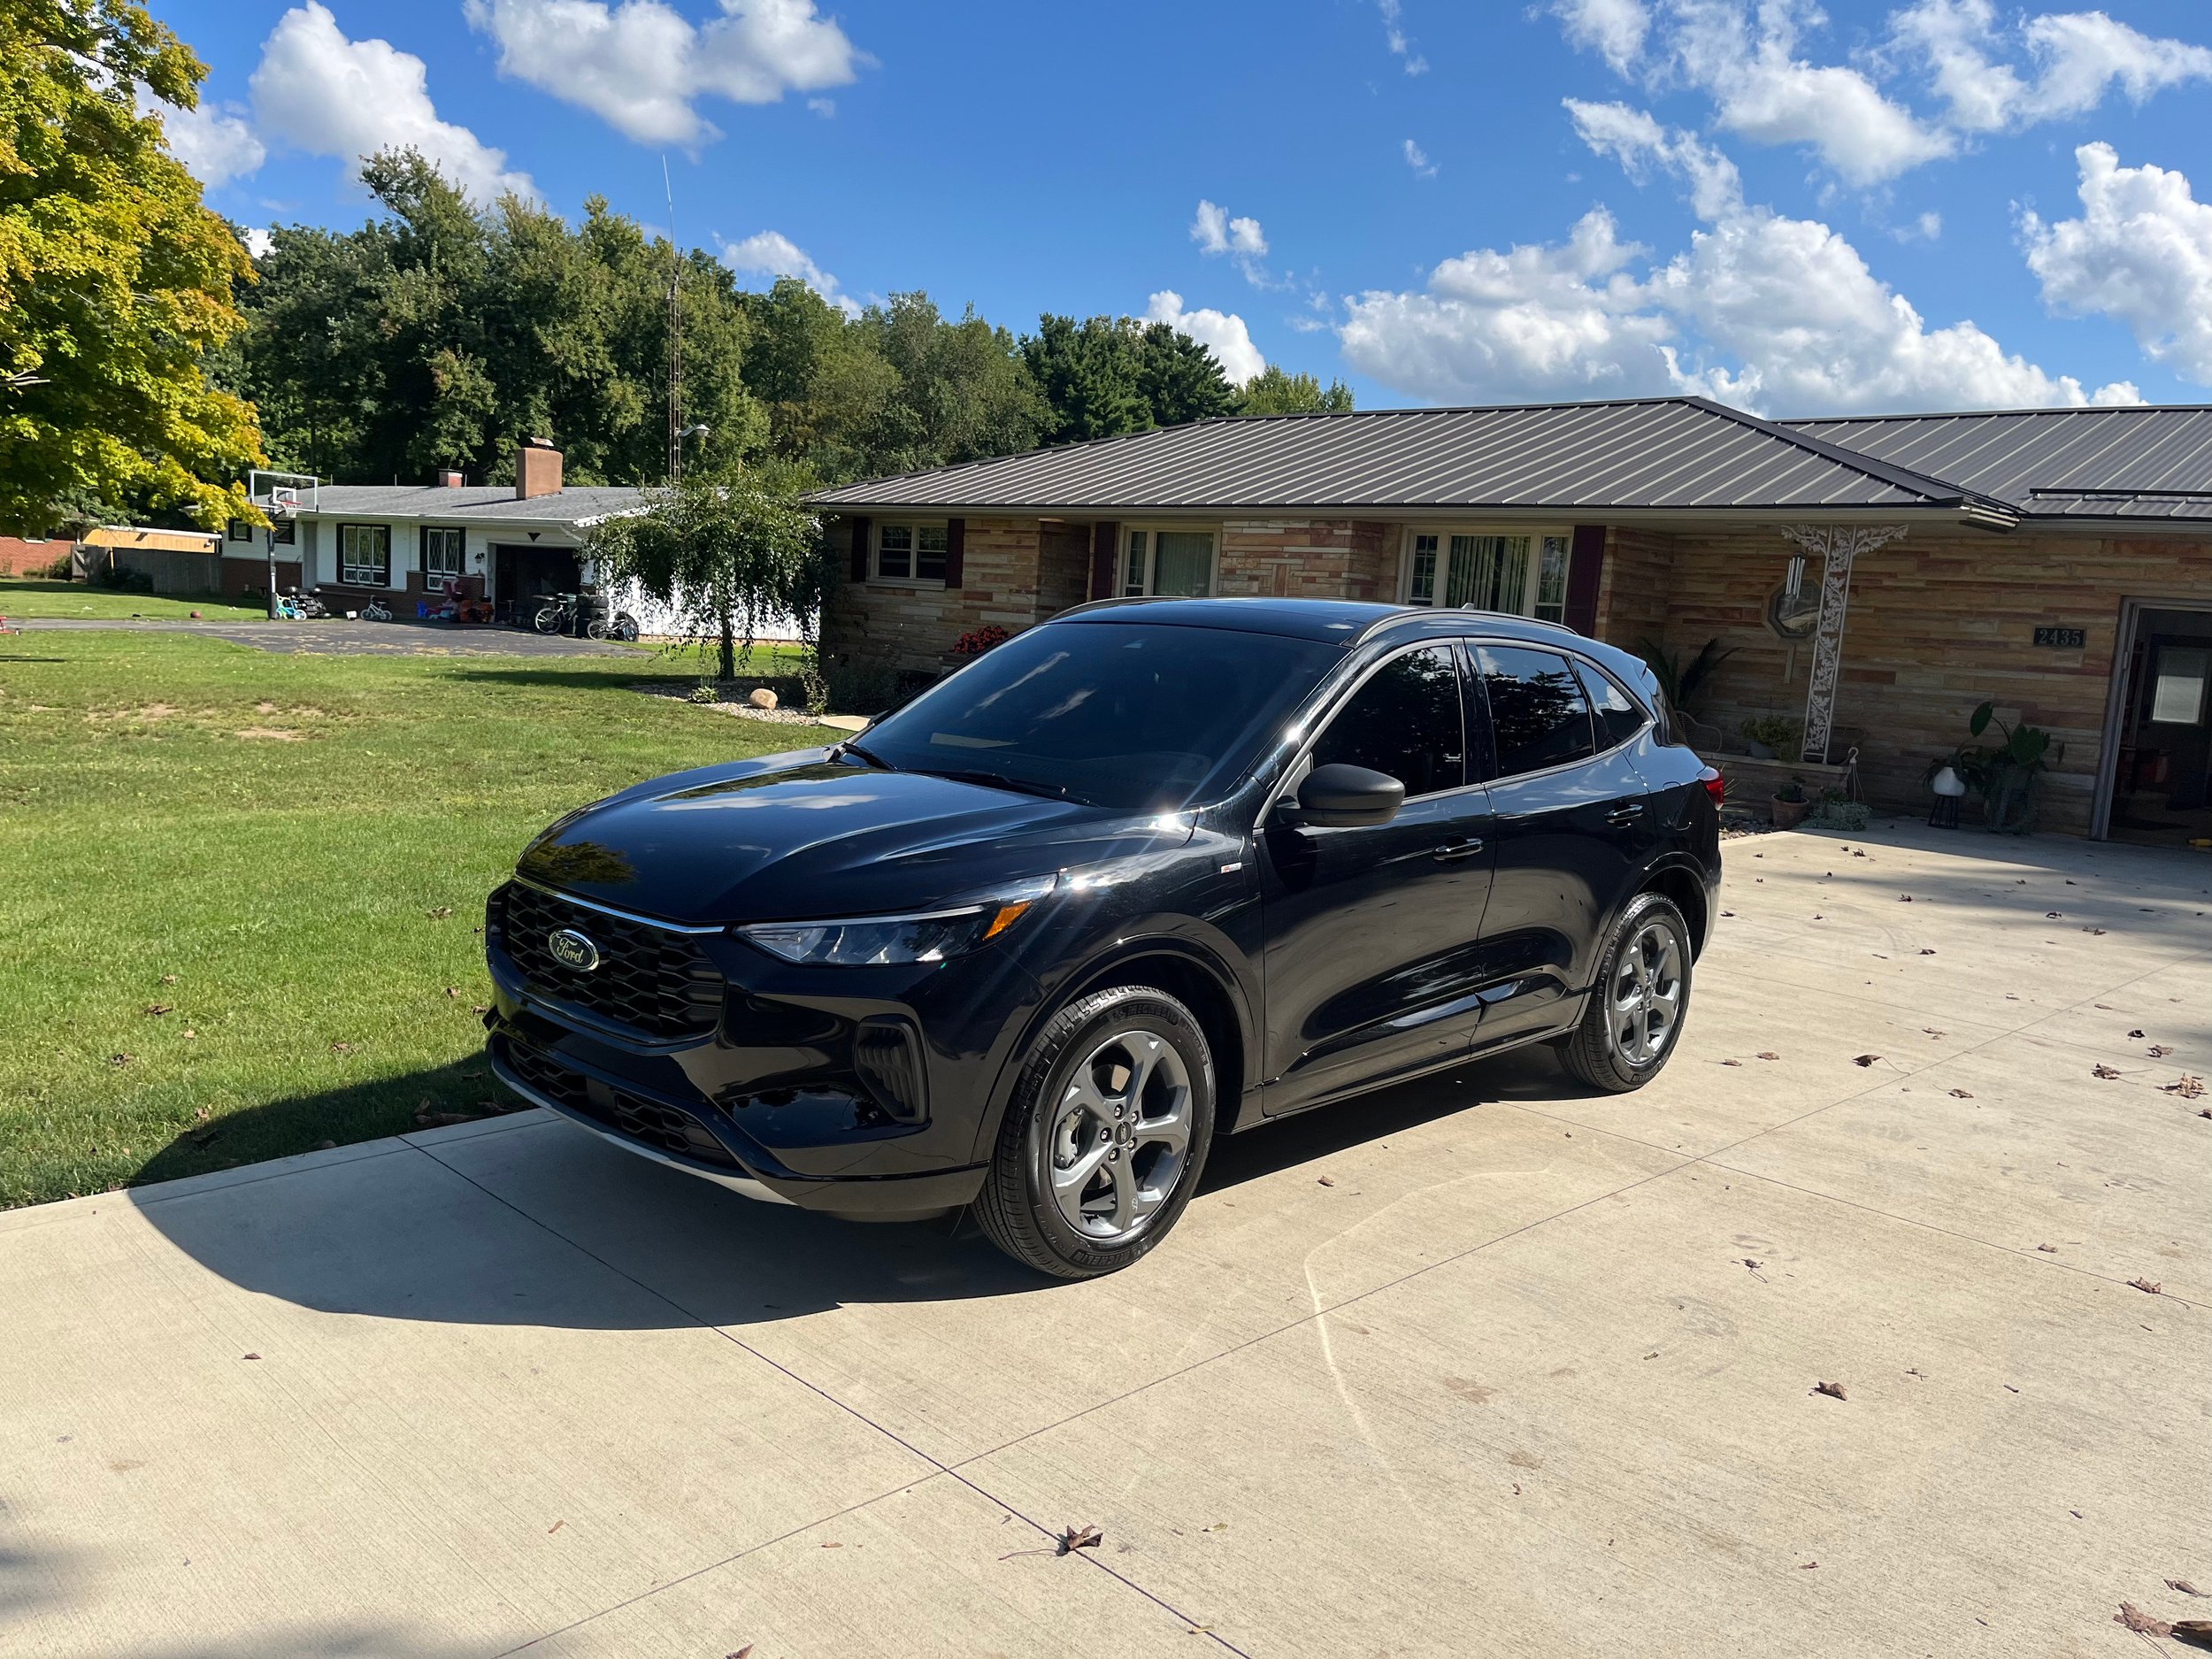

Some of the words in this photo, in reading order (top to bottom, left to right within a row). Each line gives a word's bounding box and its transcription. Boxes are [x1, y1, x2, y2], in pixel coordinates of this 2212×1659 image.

[2039, 629, 2080, 646] 2435
[557, 936, 584, 964] Ford
[1072, 1250, 1131, 1267] MICHELIN
